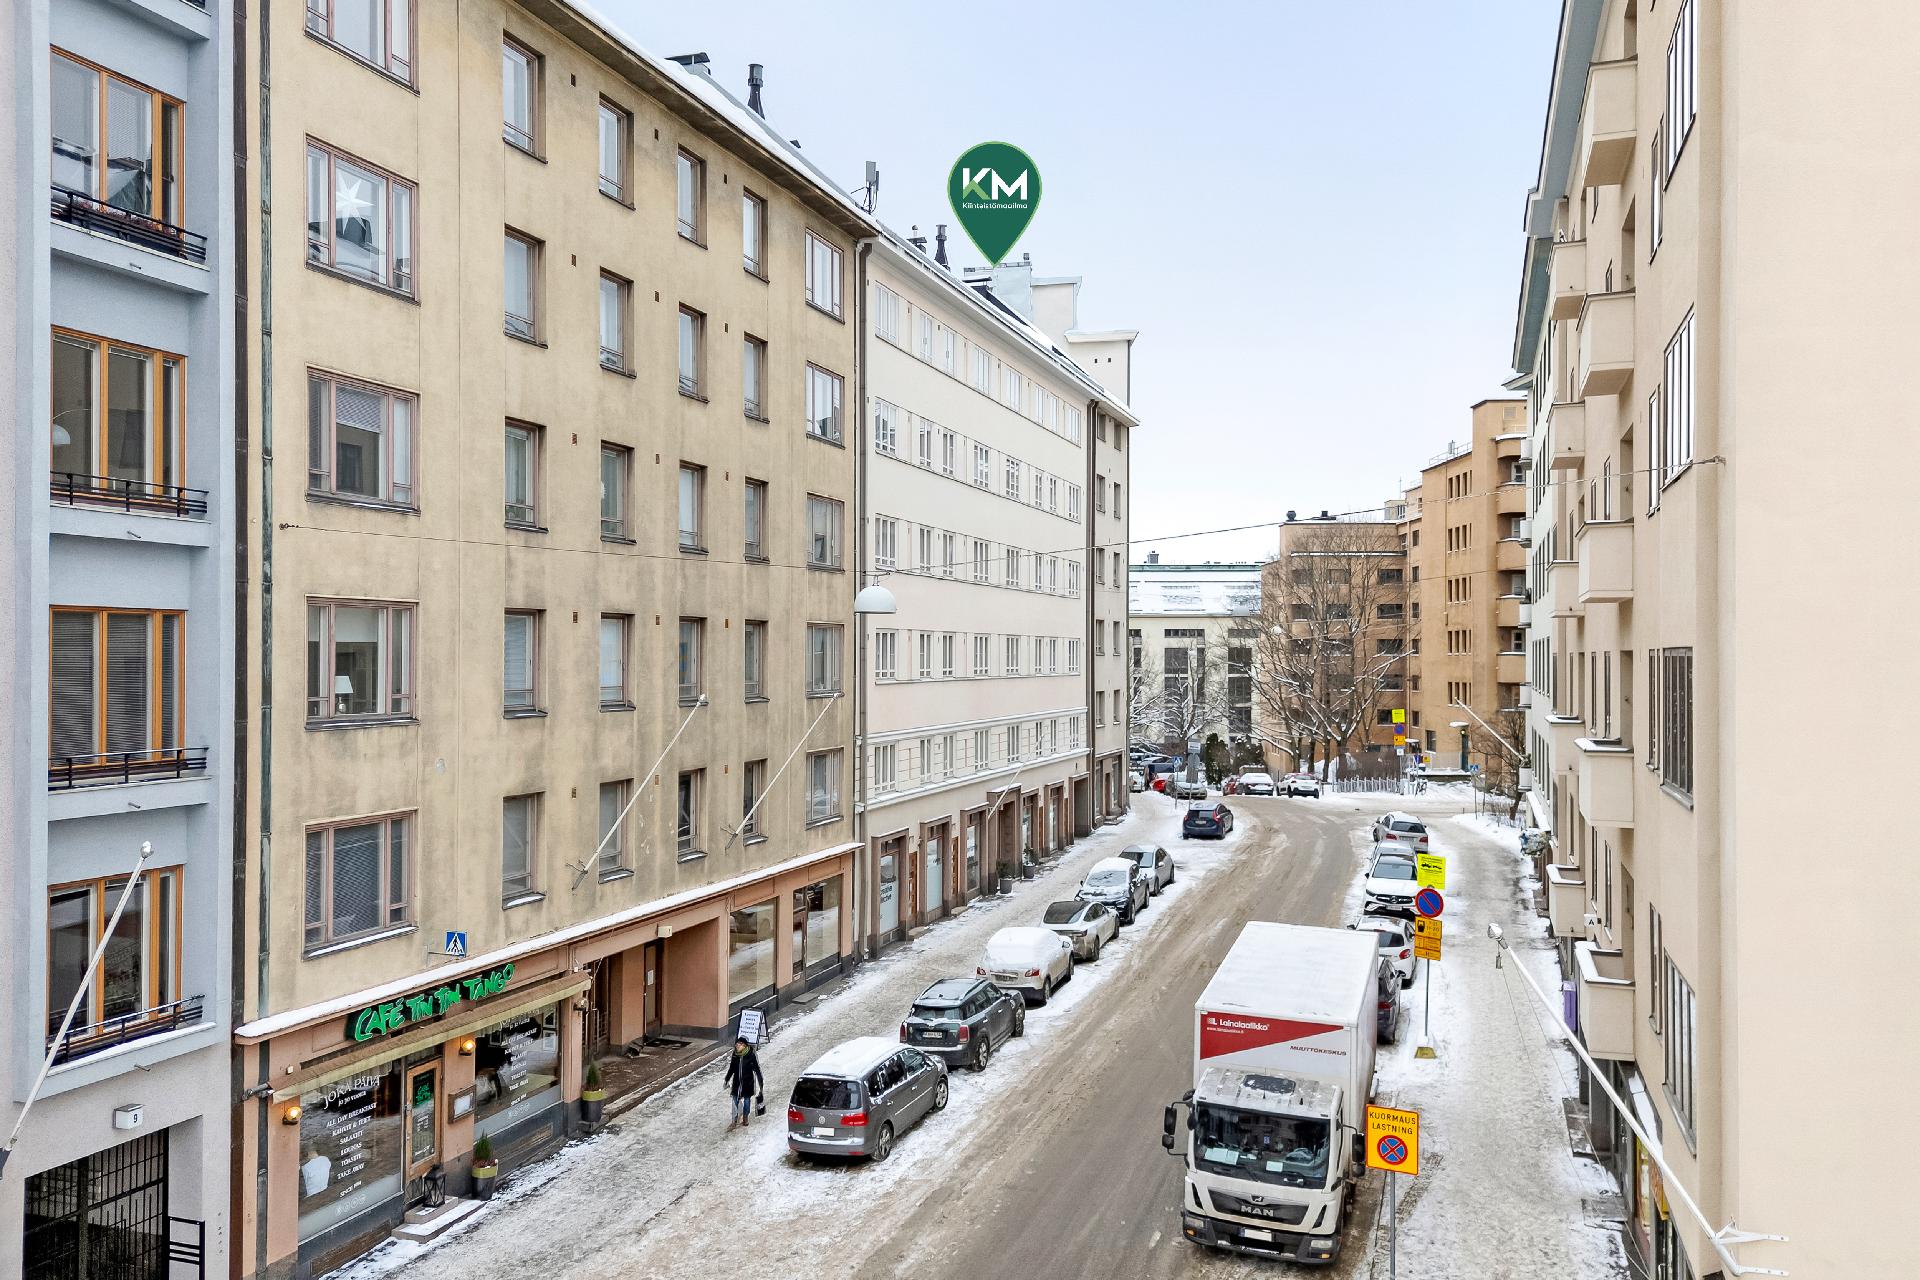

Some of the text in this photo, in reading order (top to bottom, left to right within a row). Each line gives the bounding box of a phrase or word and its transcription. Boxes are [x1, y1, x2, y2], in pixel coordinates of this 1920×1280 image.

[355, 963, 516, 1042] CAFÉ TIN TIN TANGO
[323, 1082, 352, 1110] JOKA
[133, 1113, 138, 1124] 9
[1369, 1111, 1416, 1125] KUORMAUS
[1372, 1122, 1413, 1135] LASTNING
[1240, 1205, 1274, 1217] MAN
